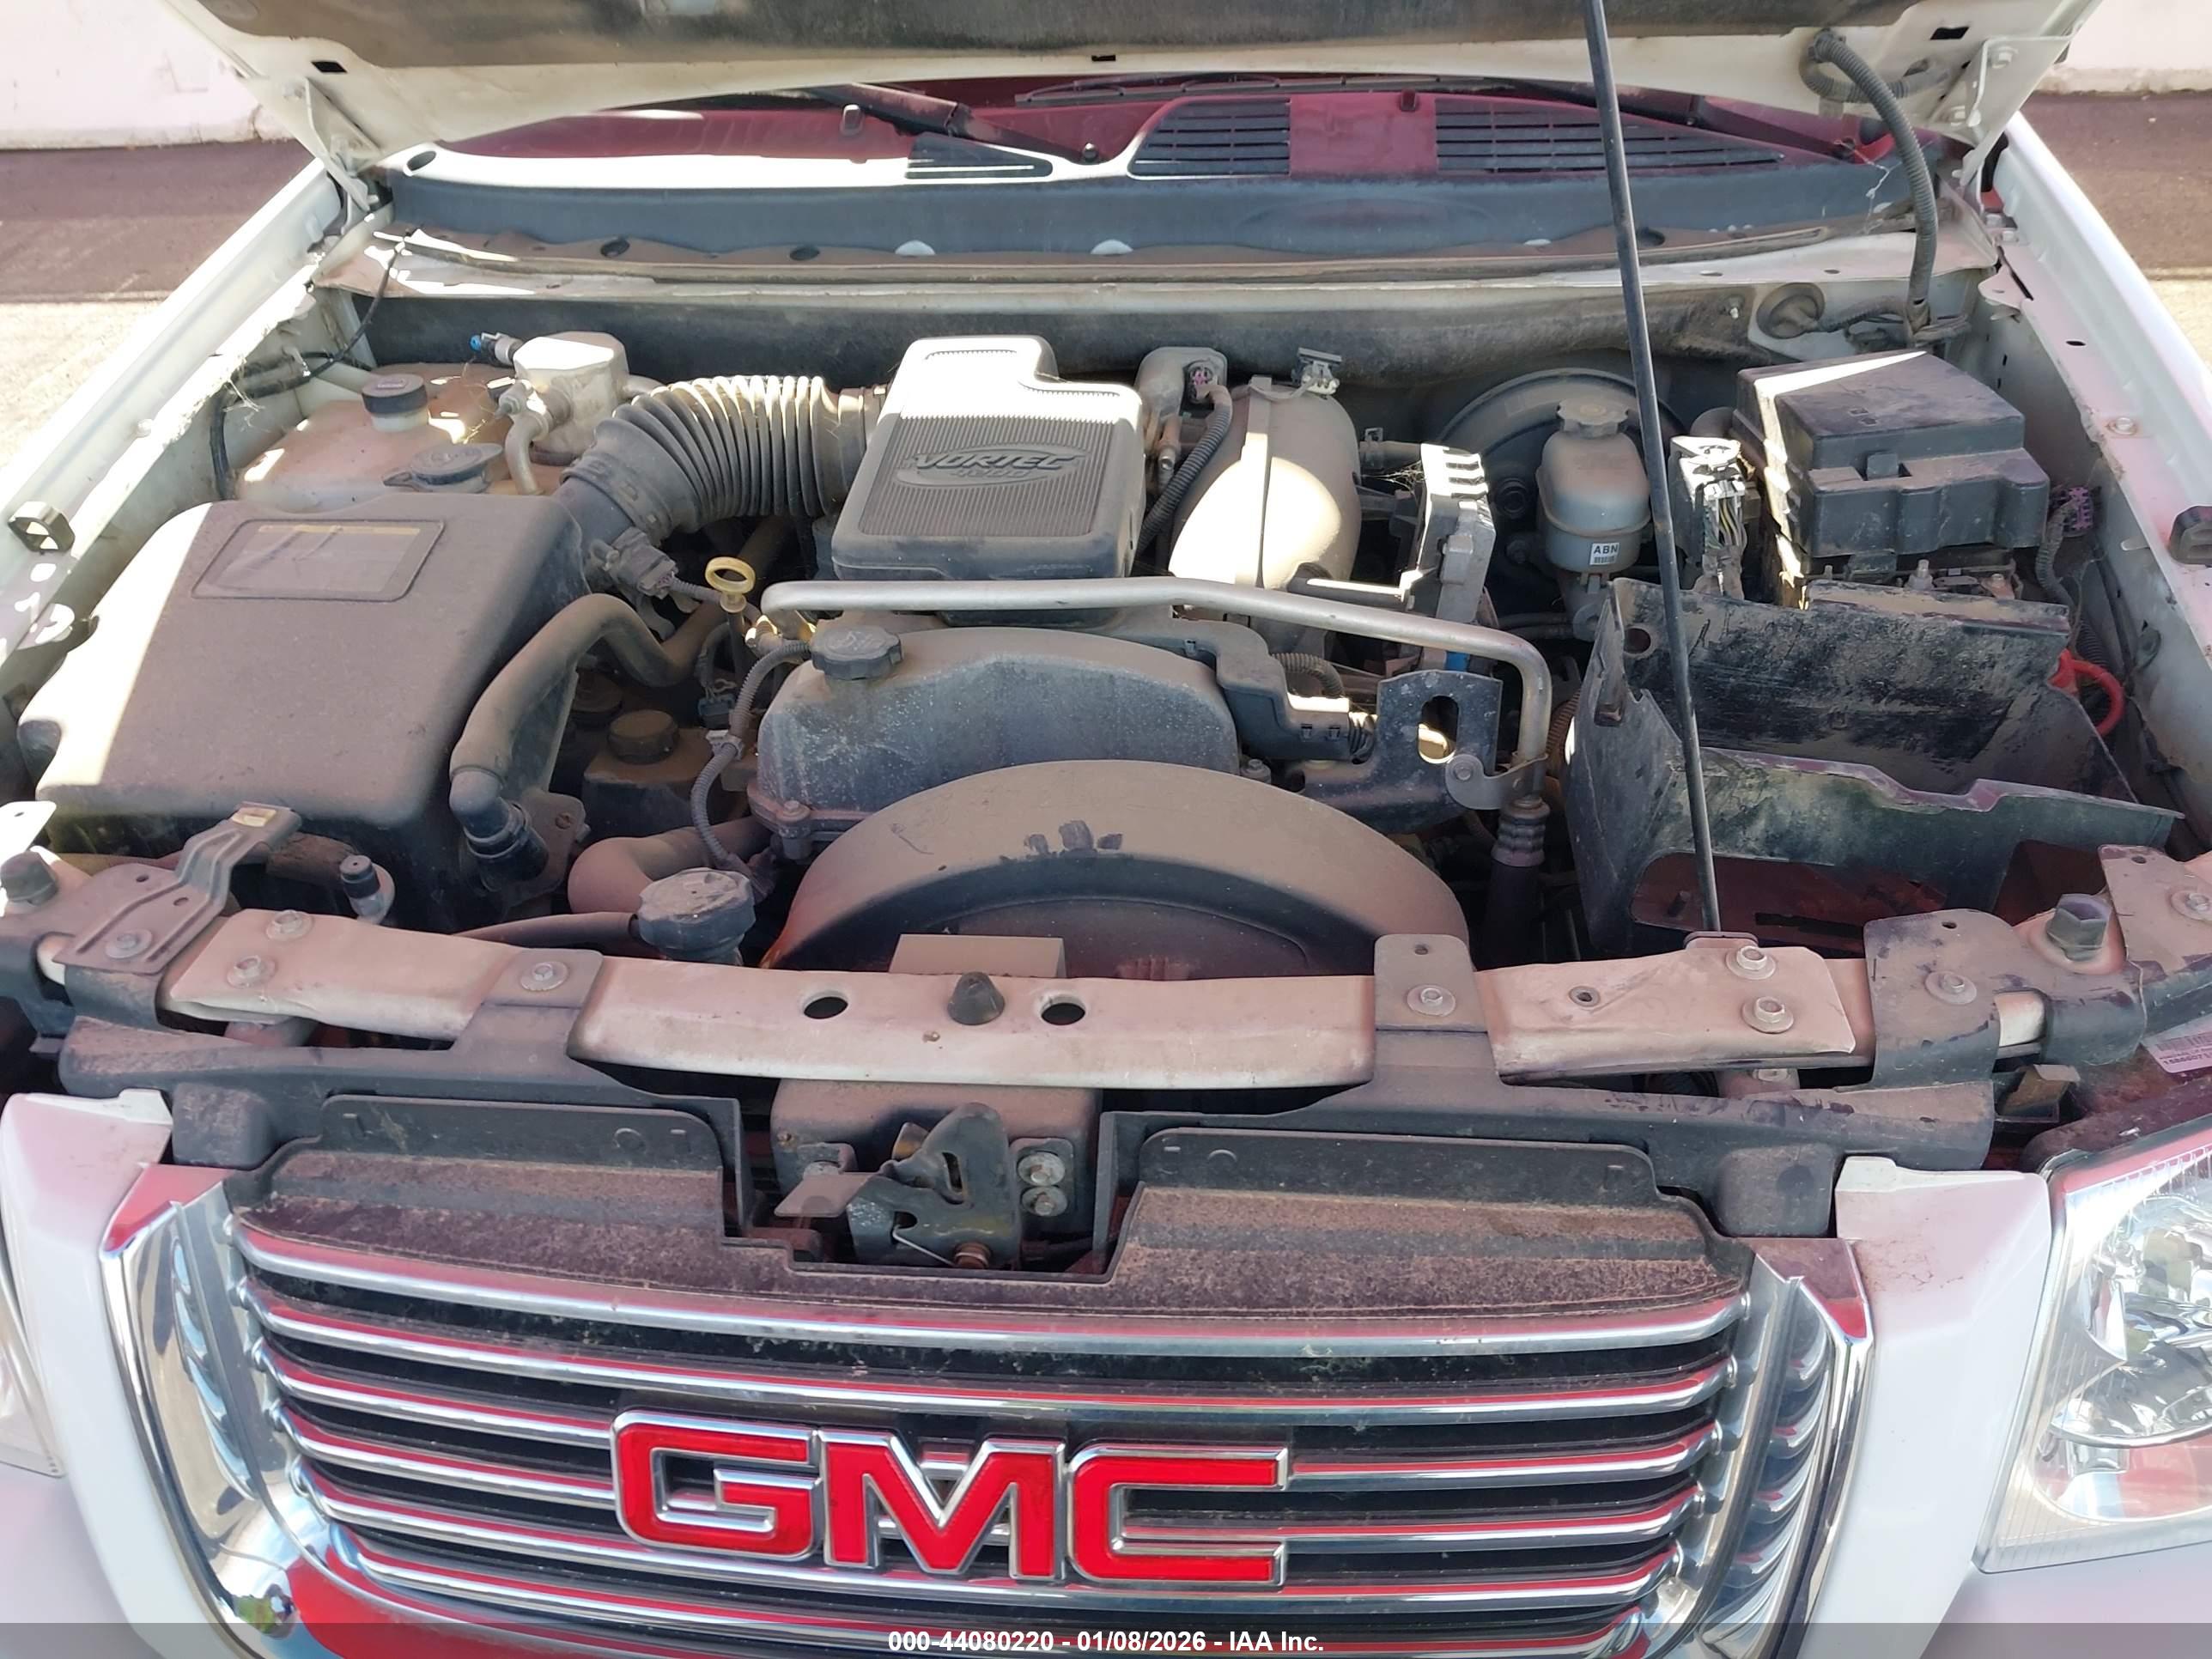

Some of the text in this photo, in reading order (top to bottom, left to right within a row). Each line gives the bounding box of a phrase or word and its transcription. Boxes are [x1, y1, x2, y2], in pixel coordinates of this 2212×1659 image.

[915, 453, 1076, 470] VORTEC
[1594, 544, 1619, 554] ABN
[611, 1410, 1289, 1587] GMC
